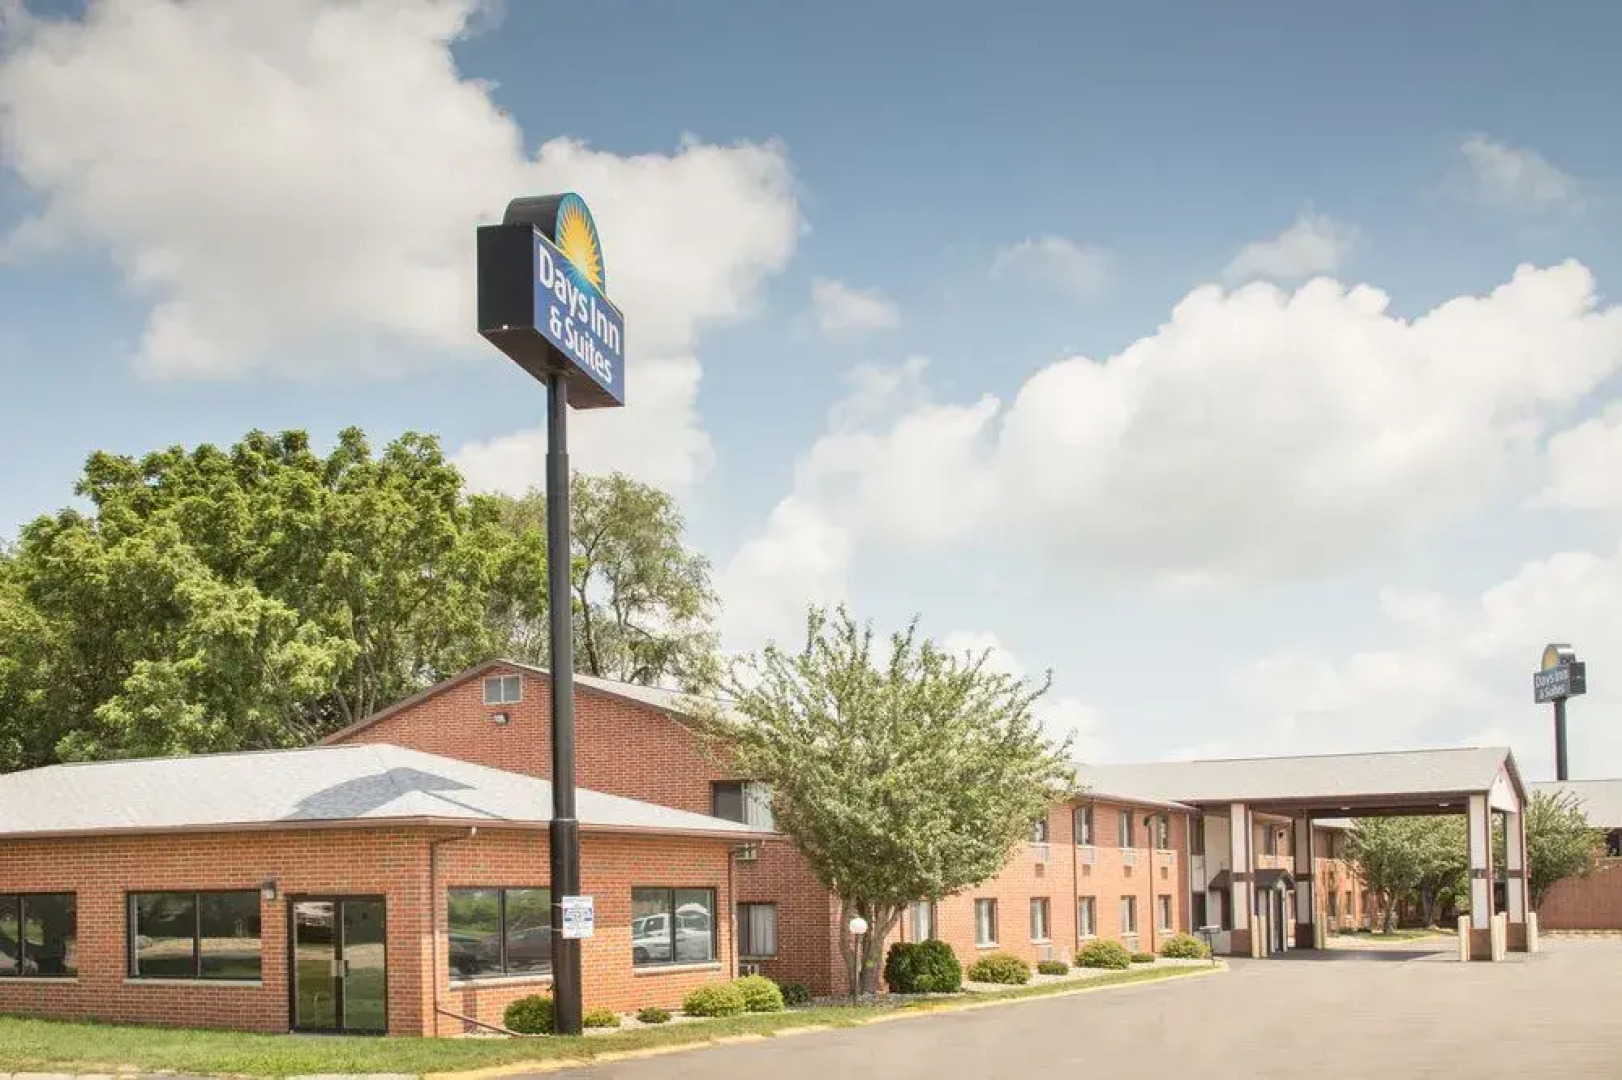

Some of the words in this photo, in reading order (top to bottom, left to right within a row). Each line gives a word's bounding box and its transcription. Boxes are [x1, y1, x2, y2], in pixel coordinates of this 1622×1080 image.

[539, 244, 588, 324] Days
[591, 298, 620, 355] Inn
[549, 305, 563, 340] &
[565, 318, 613, 384] Suites
